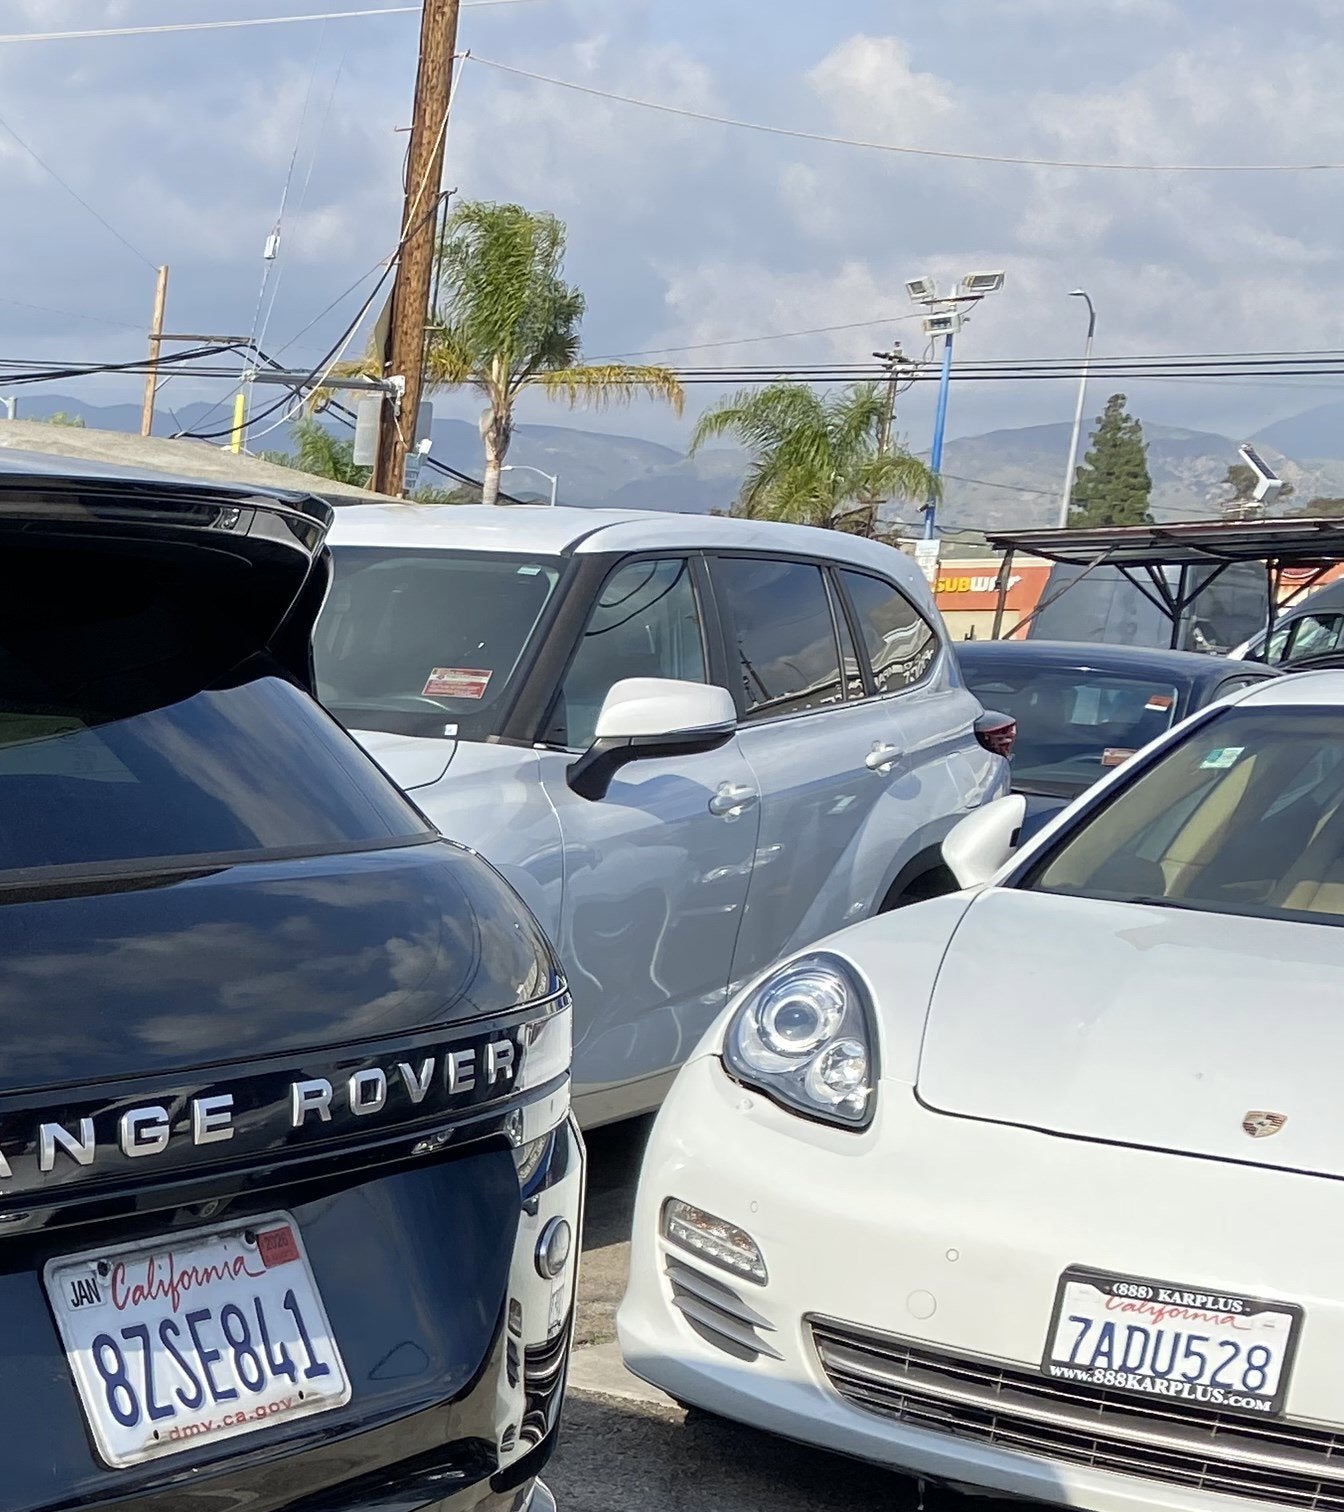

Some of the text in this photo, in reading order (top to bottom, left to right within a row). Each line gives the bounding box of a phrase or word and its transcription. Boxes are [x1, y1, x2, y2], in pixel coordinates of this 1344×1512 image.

[291, 1038, 516, 1128] ROVER
[70, 1277, 102, 1308] JAN
[111, 1248, 267, 1314] California
[1112, 1282, 1244, 1314] (888) KARPLUS
[1104, 1295, 1252, 1331] California
[91, 1288, 330, 1428] 8ZSE841
[1068, 1315, 1272, 1392] 7ADU528
[168, 1396, 294, 1441] dmv.ca.gov
